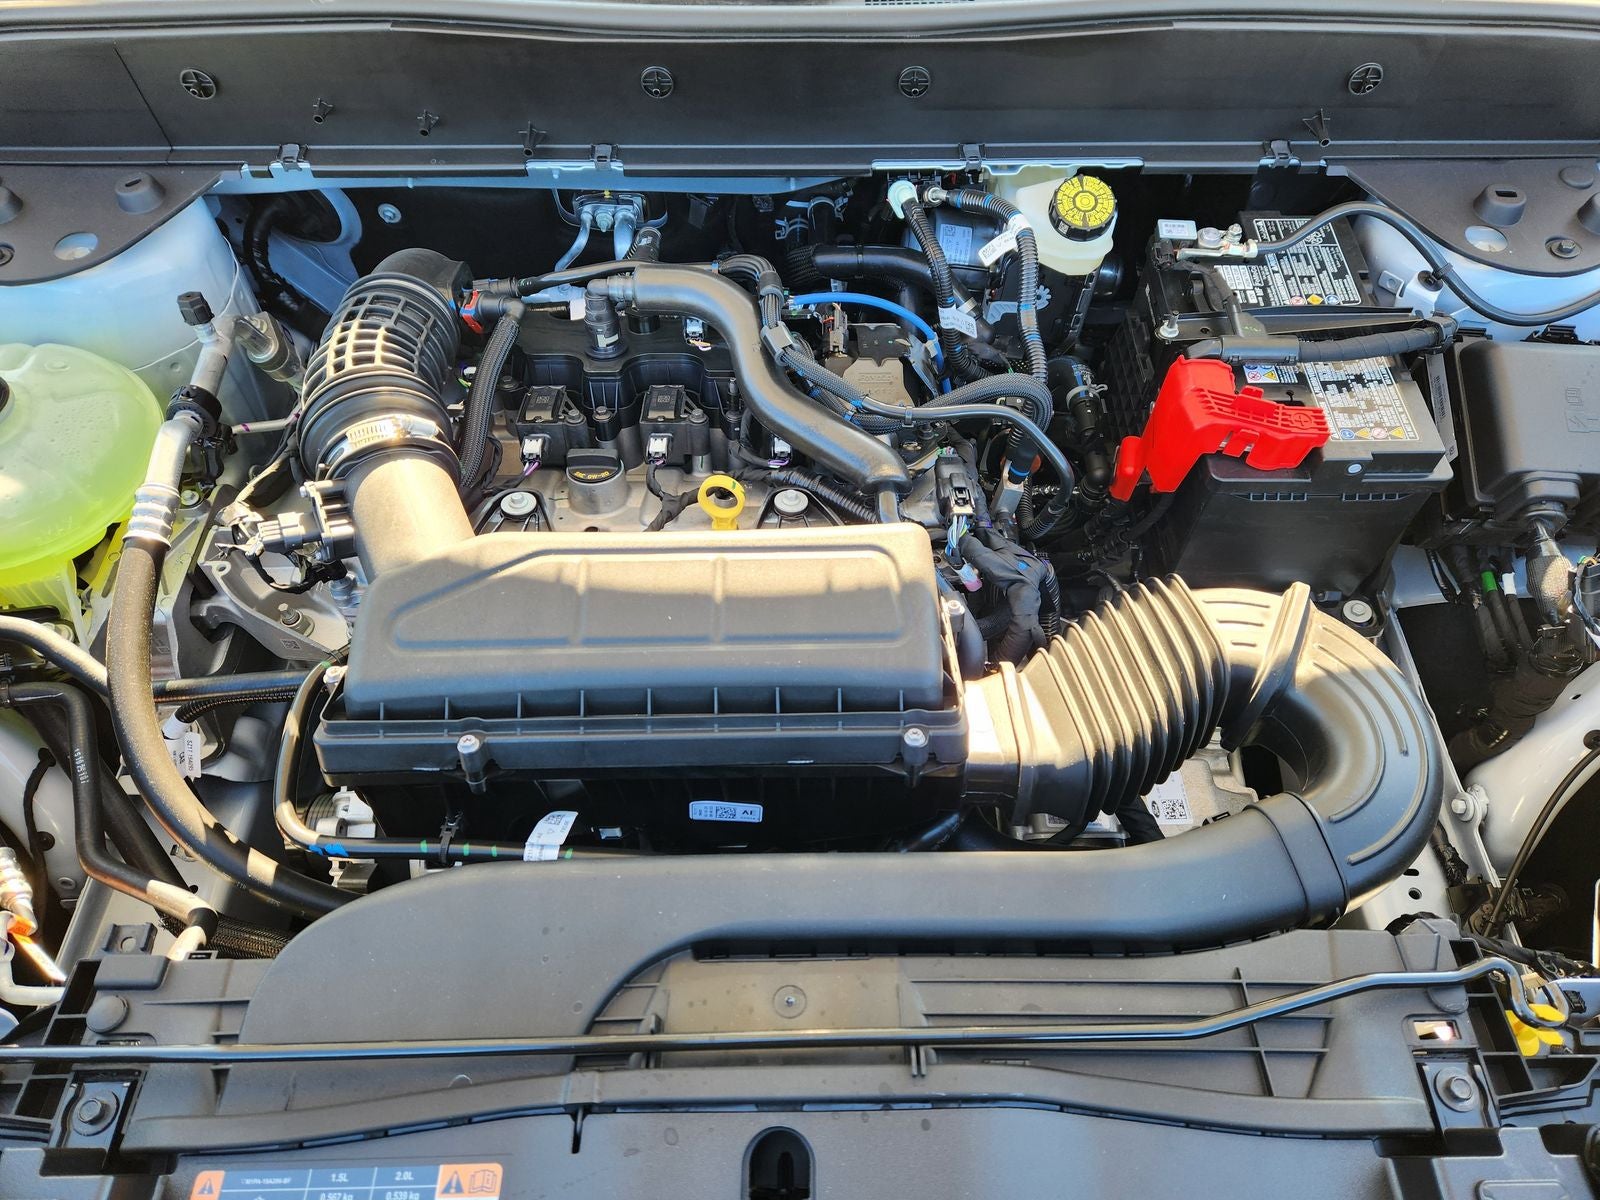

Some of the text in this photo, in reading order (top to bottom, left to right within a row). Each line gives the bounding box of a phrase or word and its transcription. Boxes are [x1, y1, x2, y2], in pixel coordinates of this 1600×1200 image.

[331, 1171, 414, 1183] 1.5L 2.0L
[342, 1192, 354, 1200] kg
[409, 1191, 421, 1200] kg
